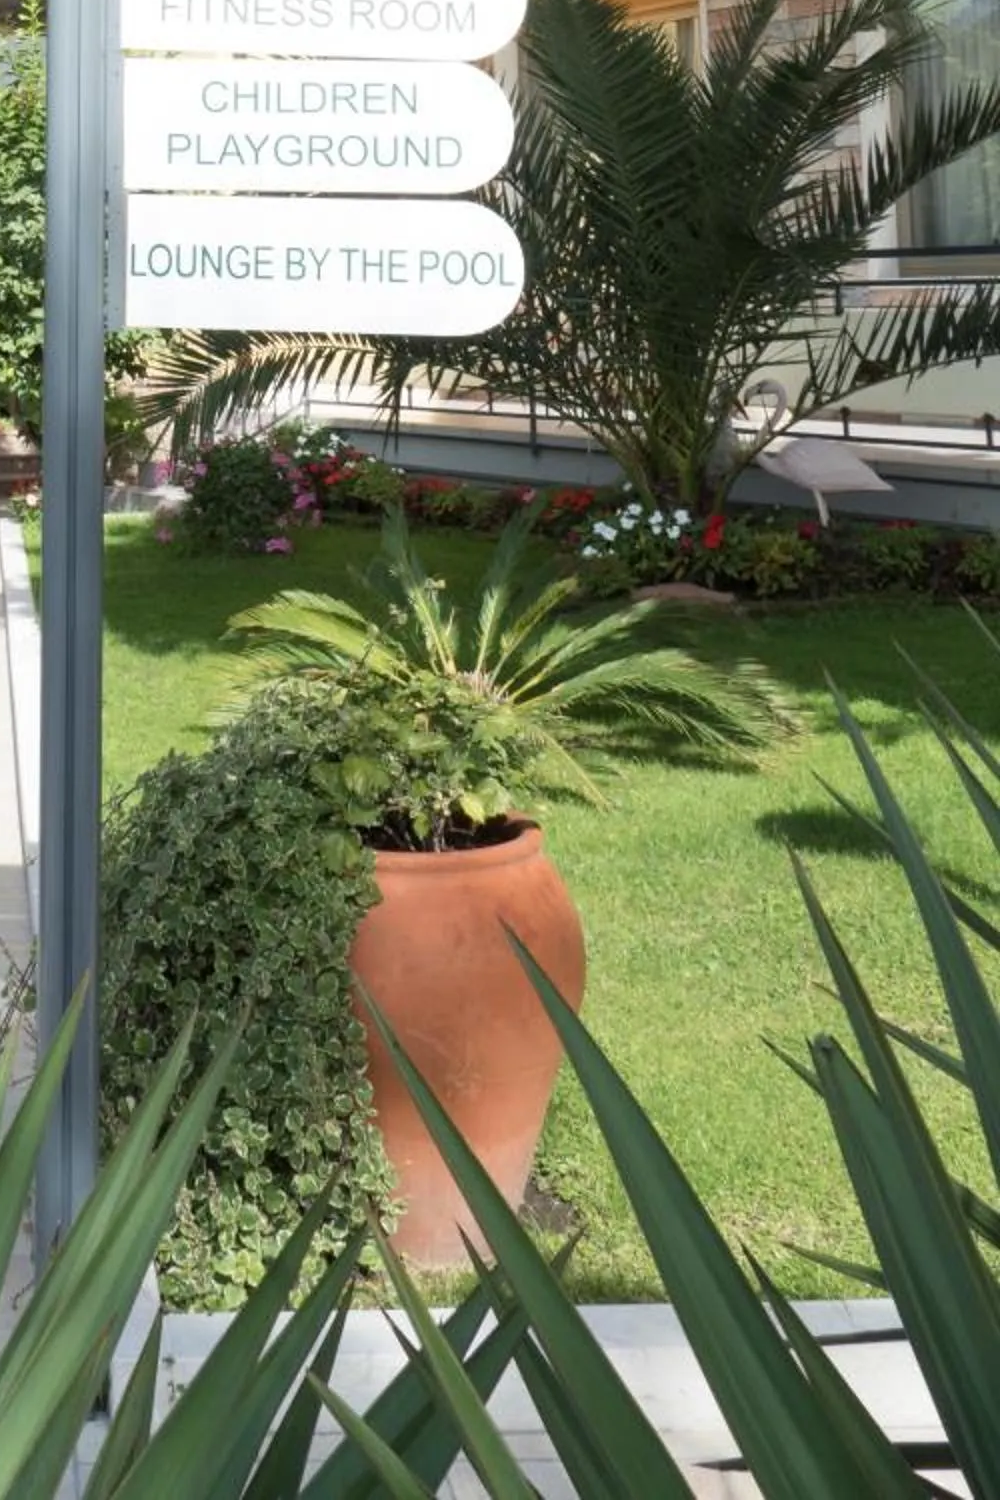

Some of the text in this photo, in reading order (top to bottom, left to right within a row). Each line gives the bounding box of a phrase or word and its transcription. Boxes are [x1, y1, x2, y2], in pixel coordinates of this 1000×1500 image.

[201, 81, 418, 114] CHILDREN
[167, 133, 463, 168] PLAYGROUND
[130, 243, 516, 286] LOUNGE BY THE POOL
